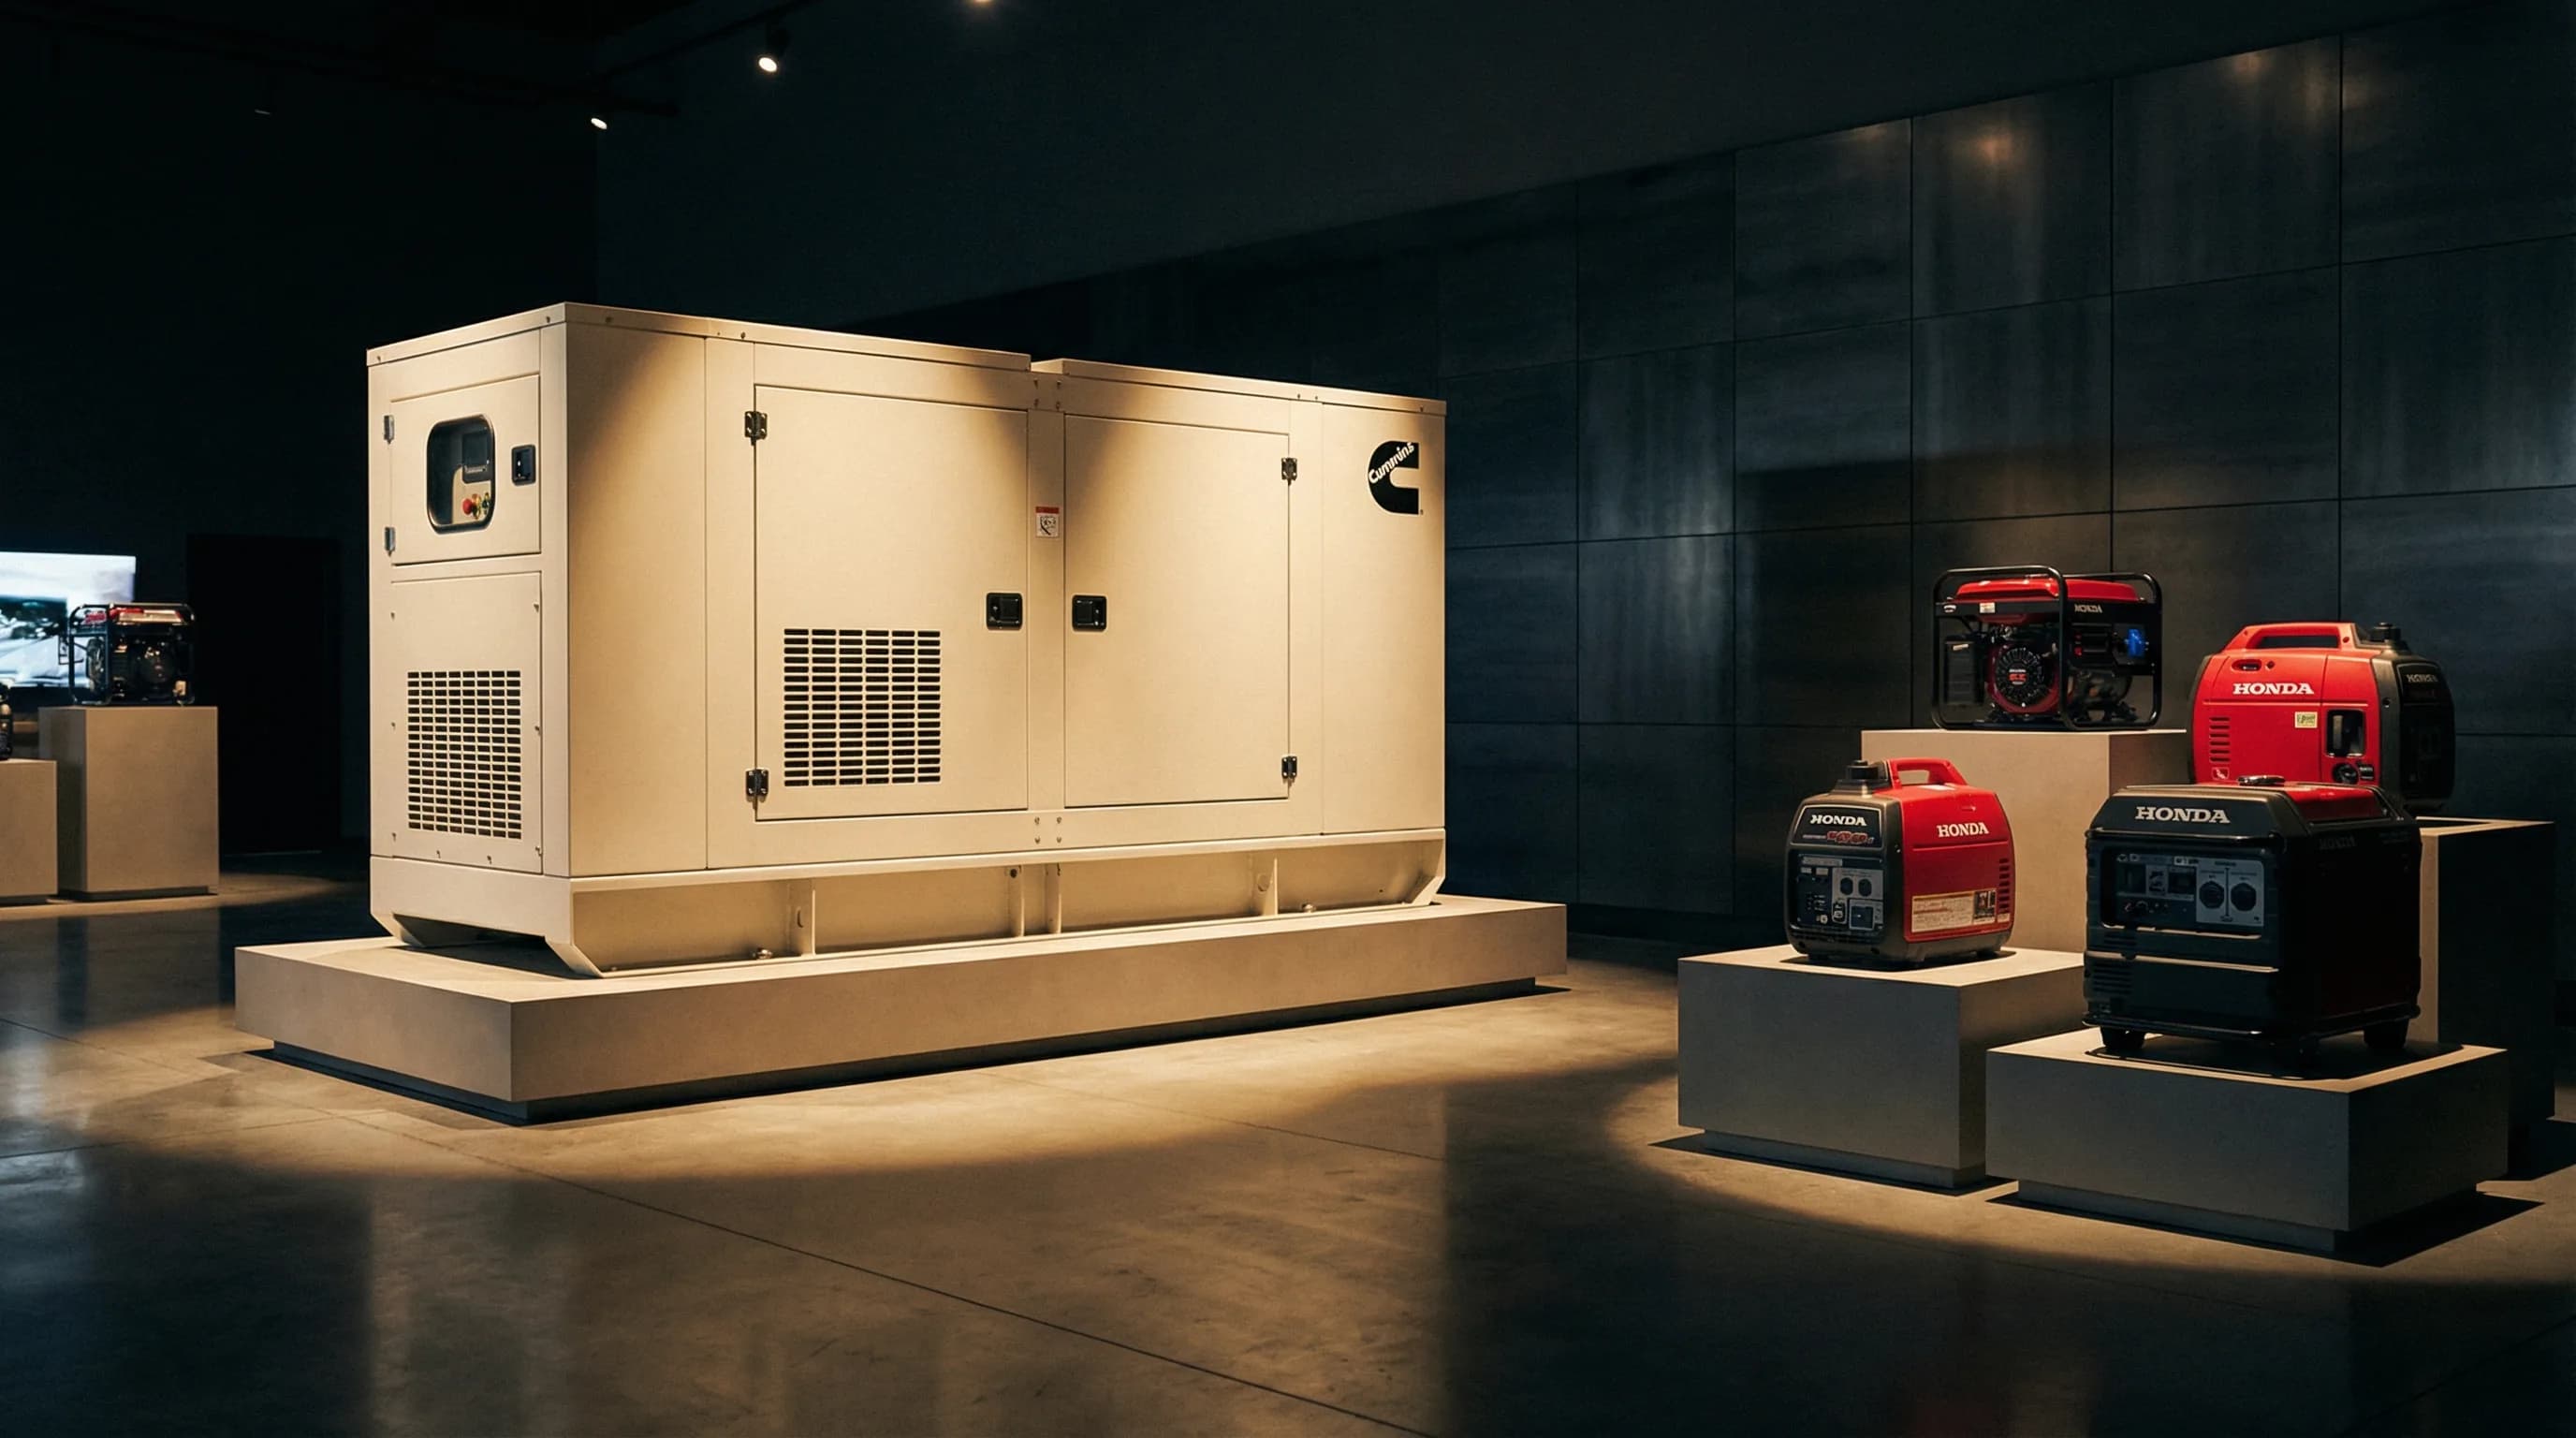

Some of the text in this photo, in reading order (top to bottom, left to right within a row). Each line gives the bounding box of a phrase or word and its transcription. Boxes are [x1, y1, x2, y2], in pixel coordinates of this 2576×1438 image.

[1368, 442, 1414, 483] Cummins
[2232, 682, 2315, 696] HONDA
[1809, 814, 1867, 827] HONDA
[2134, 806, 2231, 824] HONDA
[1936, 821, 1990, 838] HONDA
